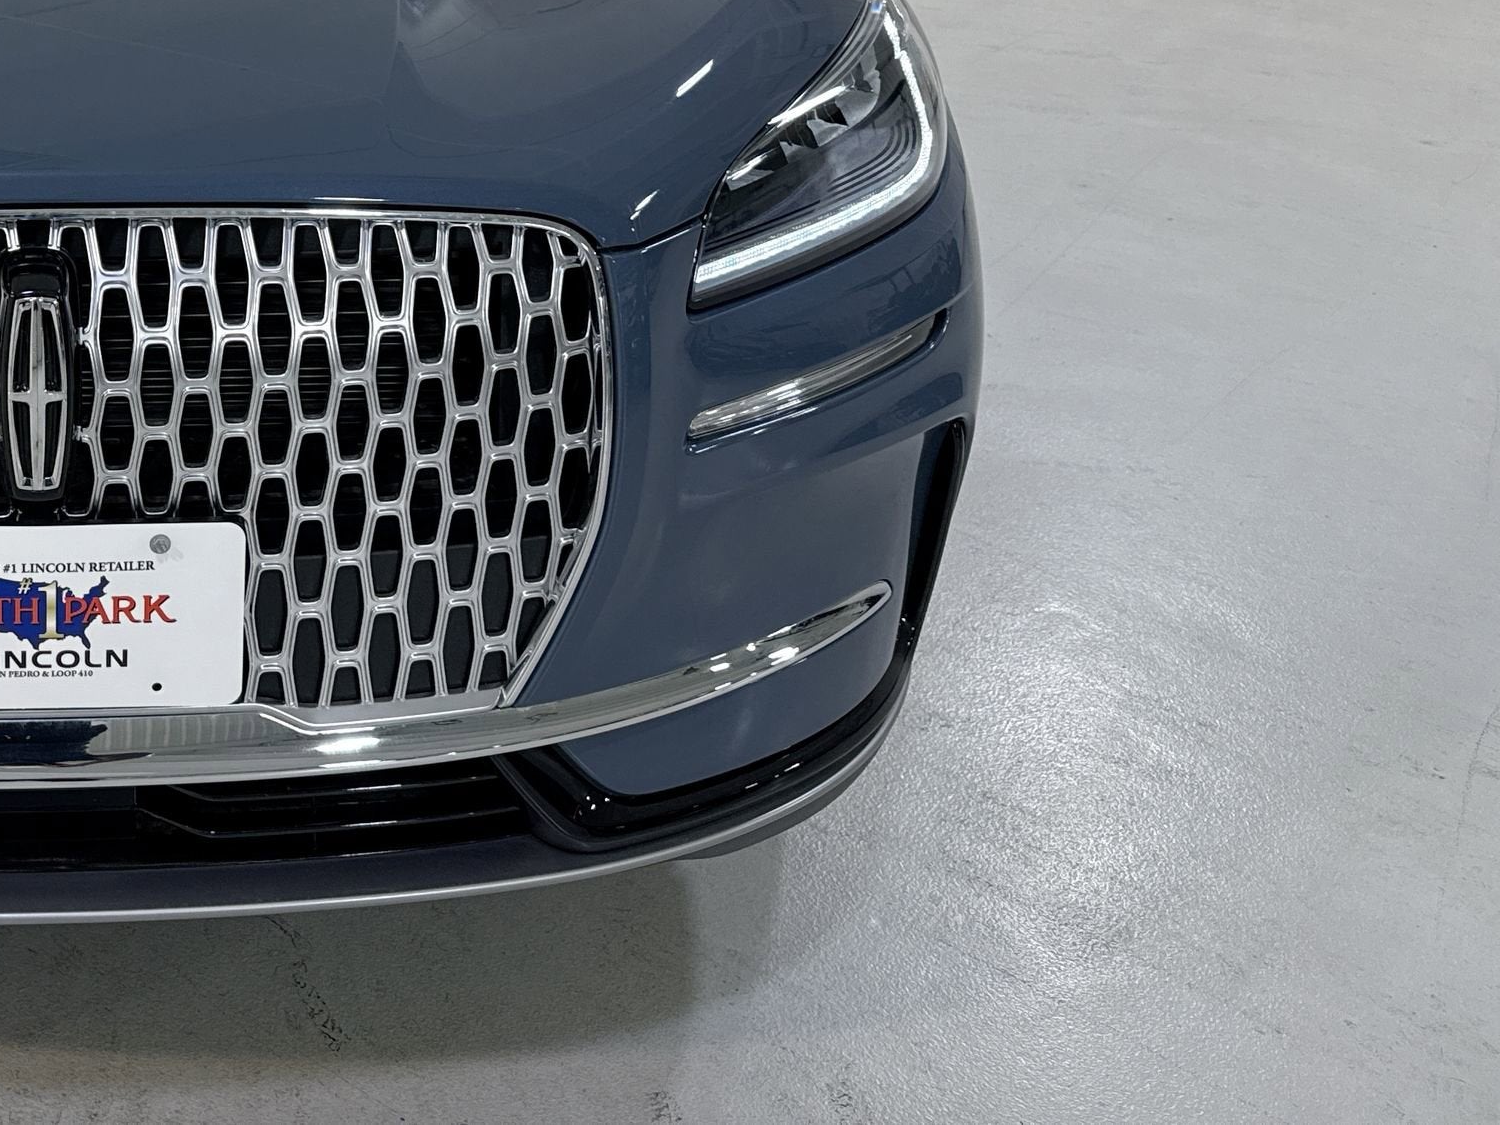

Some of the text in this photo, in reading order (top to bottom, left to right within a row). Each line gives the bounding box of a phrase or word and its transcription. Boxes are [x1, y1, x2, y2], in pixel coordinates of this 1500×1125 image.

[3, 564, 17, 573] #1
[21, 562, 85, 573] LINCOLN
[88, 560, 156, 572] RETAILER
[63, 594, 177, 625] PARK
